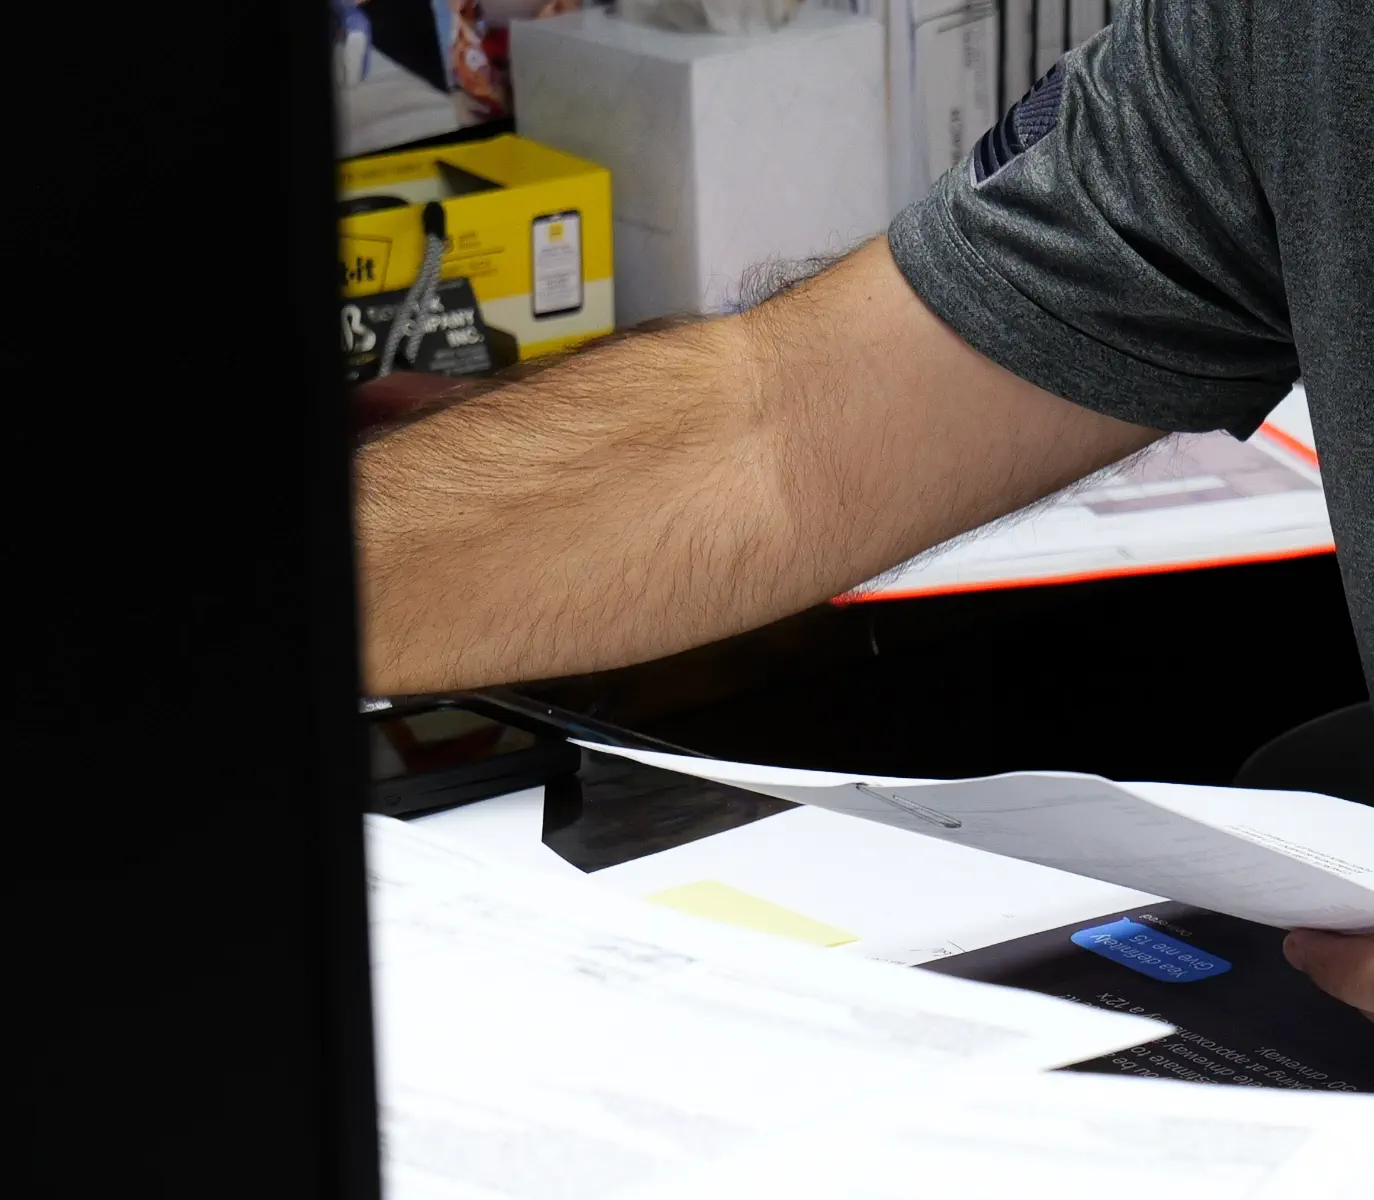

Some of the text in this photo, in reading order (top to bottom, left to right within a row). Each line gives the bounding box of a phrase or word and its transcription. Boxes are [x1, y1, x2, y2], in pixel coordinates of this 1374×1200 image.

[1090, 933, 1189, 978] Yea definitely
[1129, 934, 1214, 971] Give me 15
[1112, 1057, 1138, 1071] be
[1246, 1062, 1269, 1073] at
